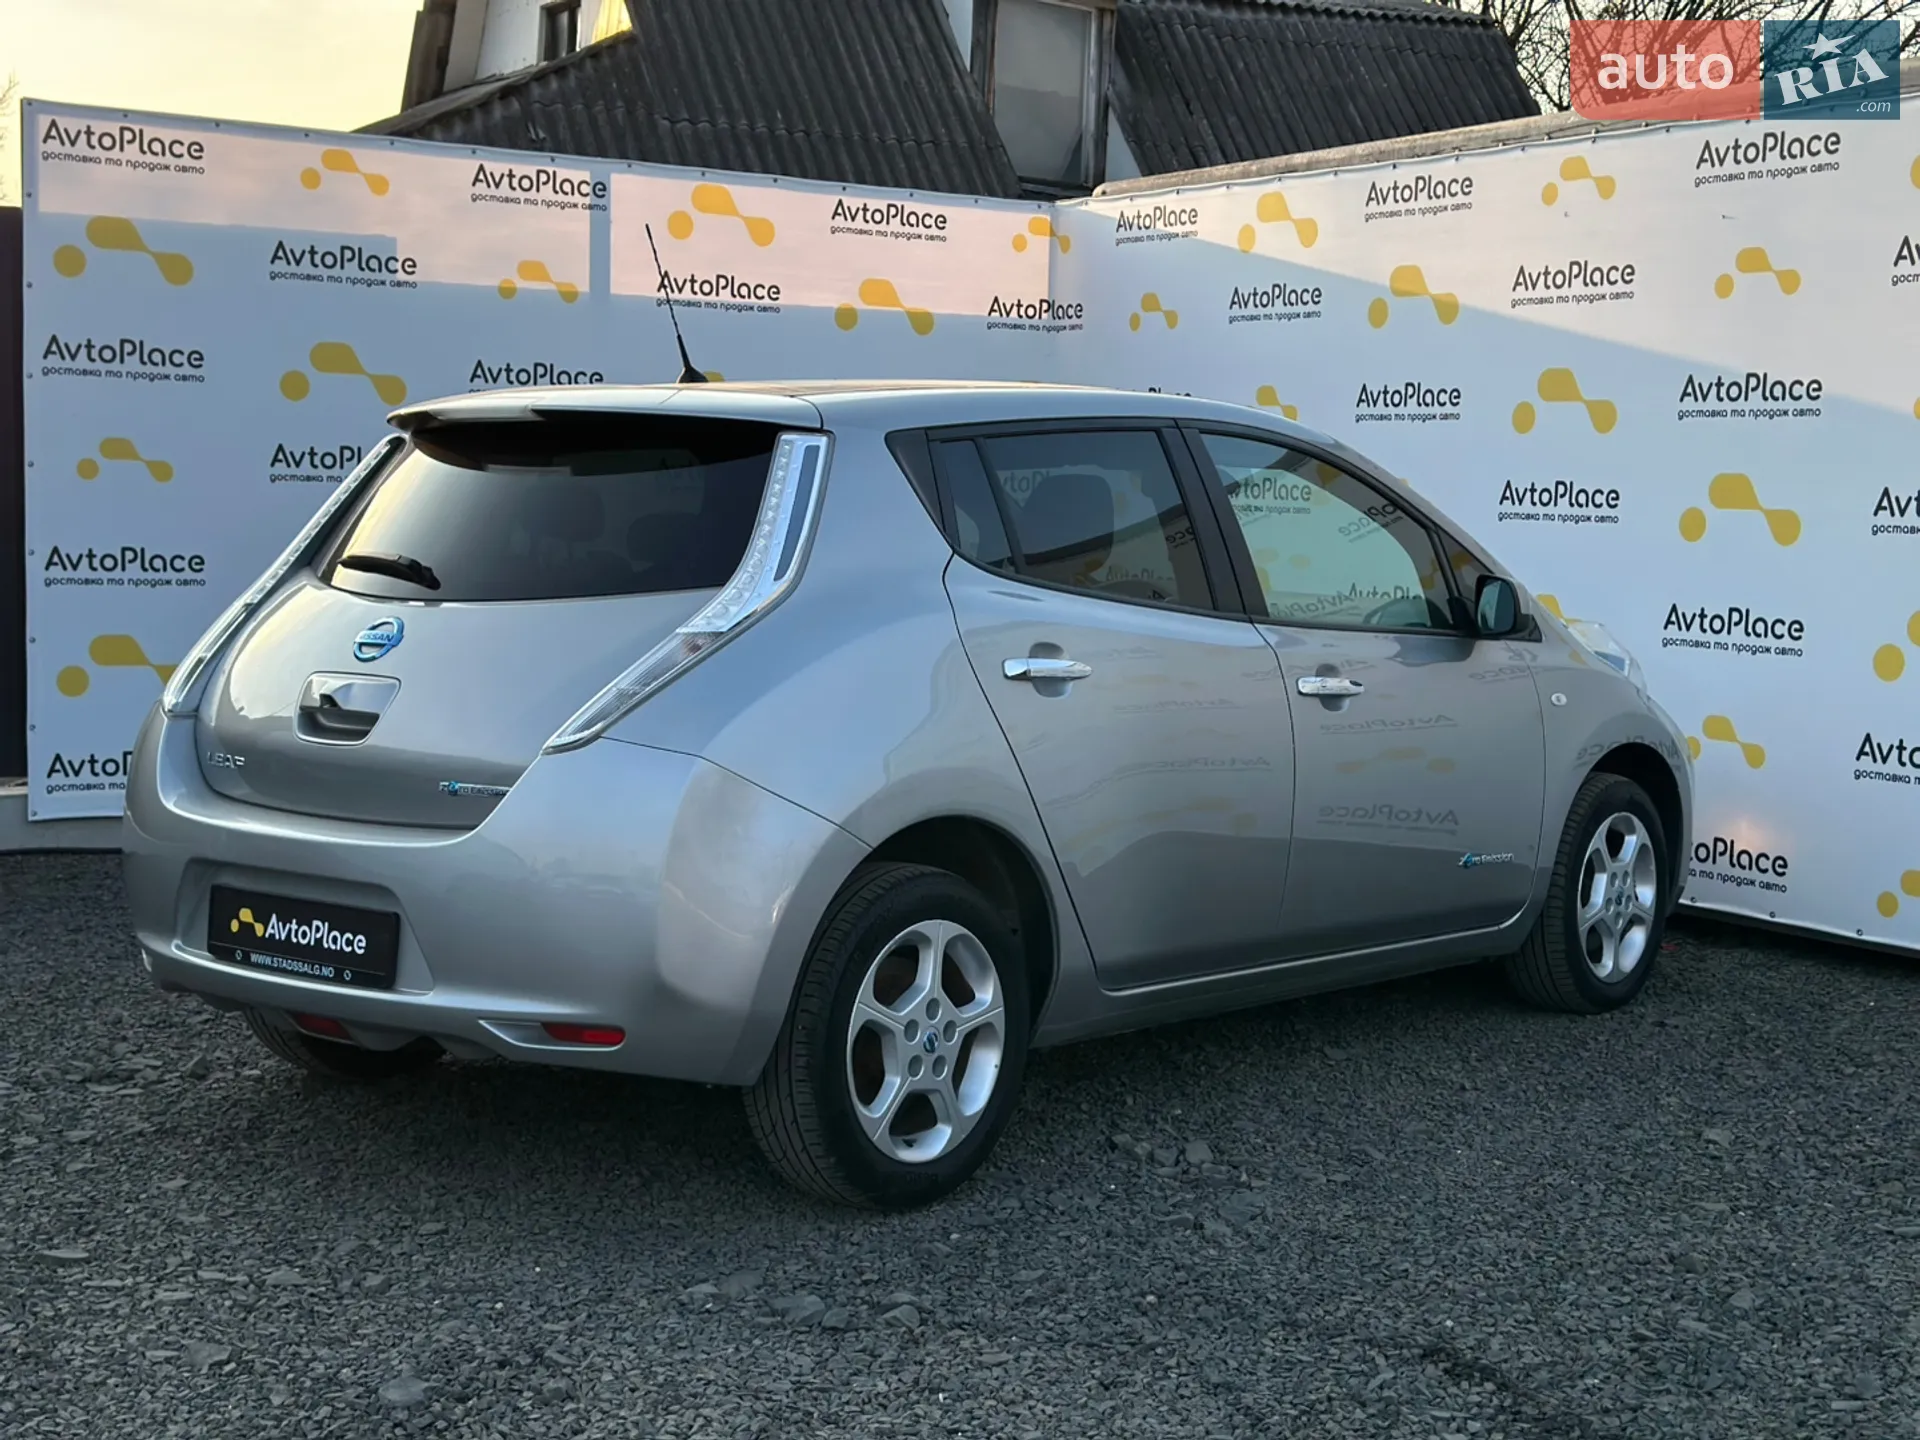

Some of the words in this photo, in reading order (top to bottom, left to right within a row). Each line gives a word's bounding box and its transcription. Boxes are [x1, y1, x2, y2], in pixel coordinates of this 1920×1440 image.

[42, 119, 205, 160] AvtoPlace
[1696, 131, 1840, 169] AvtoPlace
[42, 151, 102, 164] доставка
[105, 158, 122, 166] та
[126, 160, 170, 172] продаж
[174, 165, 205, 174] авто
[1695, 172, 1745, 188] доставка
[1748, 170, 1763, 179] та
[1766, 166, 1807, 179] продаж
[1810, 162, 1839, 173] авто
[471, 164, 608, 199] AvtoPlace
[1366, 175, 1473, 207] AvtoPlace
[471, 193, 521, 204] доставка
[523, 198, 538, 206] та
[541, 199, 578, 210] продаж
[581, 203, 608, 212] авто
[832, 199, 947, 230] AvtoPlace
[1116, 206, 1198, 232] AvtoPlace
[270, 240, 417, 275] AvtoPlace
[269, 271, 324, 282] доставка
[327, 275, 343, 283] та
[346, 277, 386, 287] продаж
[390, 280, 417, 289] авто
[657, 270, 780, 301] AvtoPlace
[1512, 260, 1635, 292] AvtoPlace
[988, 296, 1083, 320] AvtoPlace
[1230, 283, 1322, 310] AvtoPlace
[1511, 296, 1554, 308] доставка
[1556, 295, 1569, 303] та
[1572, 293, 1607, 304] продаж
[1609, 291, 1634, 300] авто
[43, 334, 206, 369] AvtoPlace
[42, 366, 102, 377] доставка
[105, 370, 123, 378] та
[126, 371, 171, 382] продаж
[174, 374, 206, 383] авто
[469, 359, 604, 386] AvtoPlace
[1356, 382, 1461, 408] AvtoPlace
[1680, 372, 1822, 402] AvtoPlace
[1678, 410, 1727, 421] доставка
[1731, 409, 1746, 417] та
[1748, 409, 1789, 420] продаж
[1792, 408, 1821, 417] авто
[269, 473, 324, 483] доставка
[1230, 478, 1312, 502] toPlace
[1499, 480, 1619, 509] AvtoPlace
[1498, 512, 1540, 522] доставка
[1558, 514, 1592, 525] продаж
[1594, 515, 1619, 523] авто
[45, 546, 205, 573] AvtoPlace
[44, 577, 104, 587] доставка
[107, 578, 124, 586] та
[128, 578, 172, 588] продаж
[175, 578, 207, 587] авто
[1664, 603, 1804, 641] AvtoPlace
[1662, 638, 1711, 649] доставка
[1714, 642, 1729, 650] та
[1732, 643, 1771, 655] продаж
[1774, 647, 1803, 657] авто
[46, 782, 106, 795] доставка
[108, 782, 126, 790] та
[1853, 769, 1911, 784] доставка
[1690, 836, 1788, 877] oPlace
[1716, 873, 1757, 887] продаж
[1759, 881, 1787, 893] авто
[266, 913, 367, 954] AvtoPlace
[250, 952, 335, 978] WWW.STADSSALG.NO
